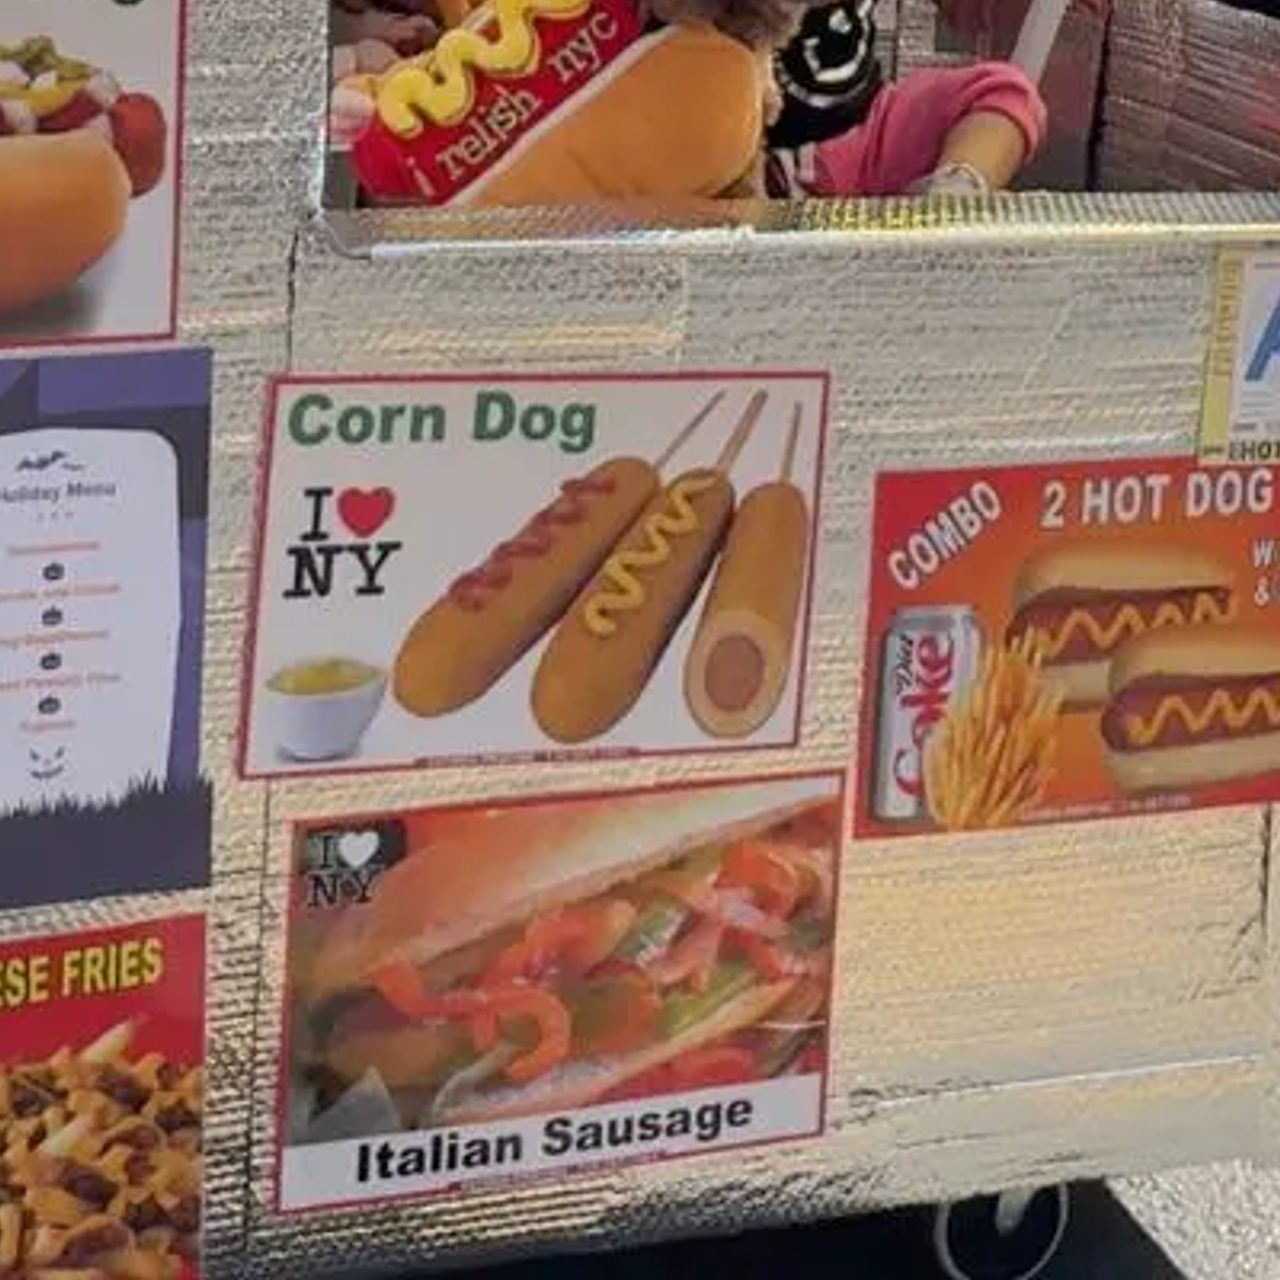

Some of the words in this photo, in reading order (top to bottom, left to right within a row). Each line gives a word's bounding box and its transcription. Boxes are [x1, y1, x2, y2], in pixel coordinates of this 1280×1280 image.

[435, 82, 544, 181] relish
[546, 11, 618, 85] nyc
[287, 391, 447, 446] Corn
[472, 389, 597, 453] Dog
[66, 479, 117, 500] Menu
[1040, 480, 1069, 529] 2
[1081, 472, 1174, 526] HOT
[1185, 467, 1275, 517] DOG
[886, 479, 1004, 591] COMBO
[282, 541, 402, 599] NY
[1253, 575, 1270, 607] &
[61, 936, 164, 997] FRIES
[356, 1128, 523, 1183] Italian
[541, 1094, 755, 1157] Sausage
